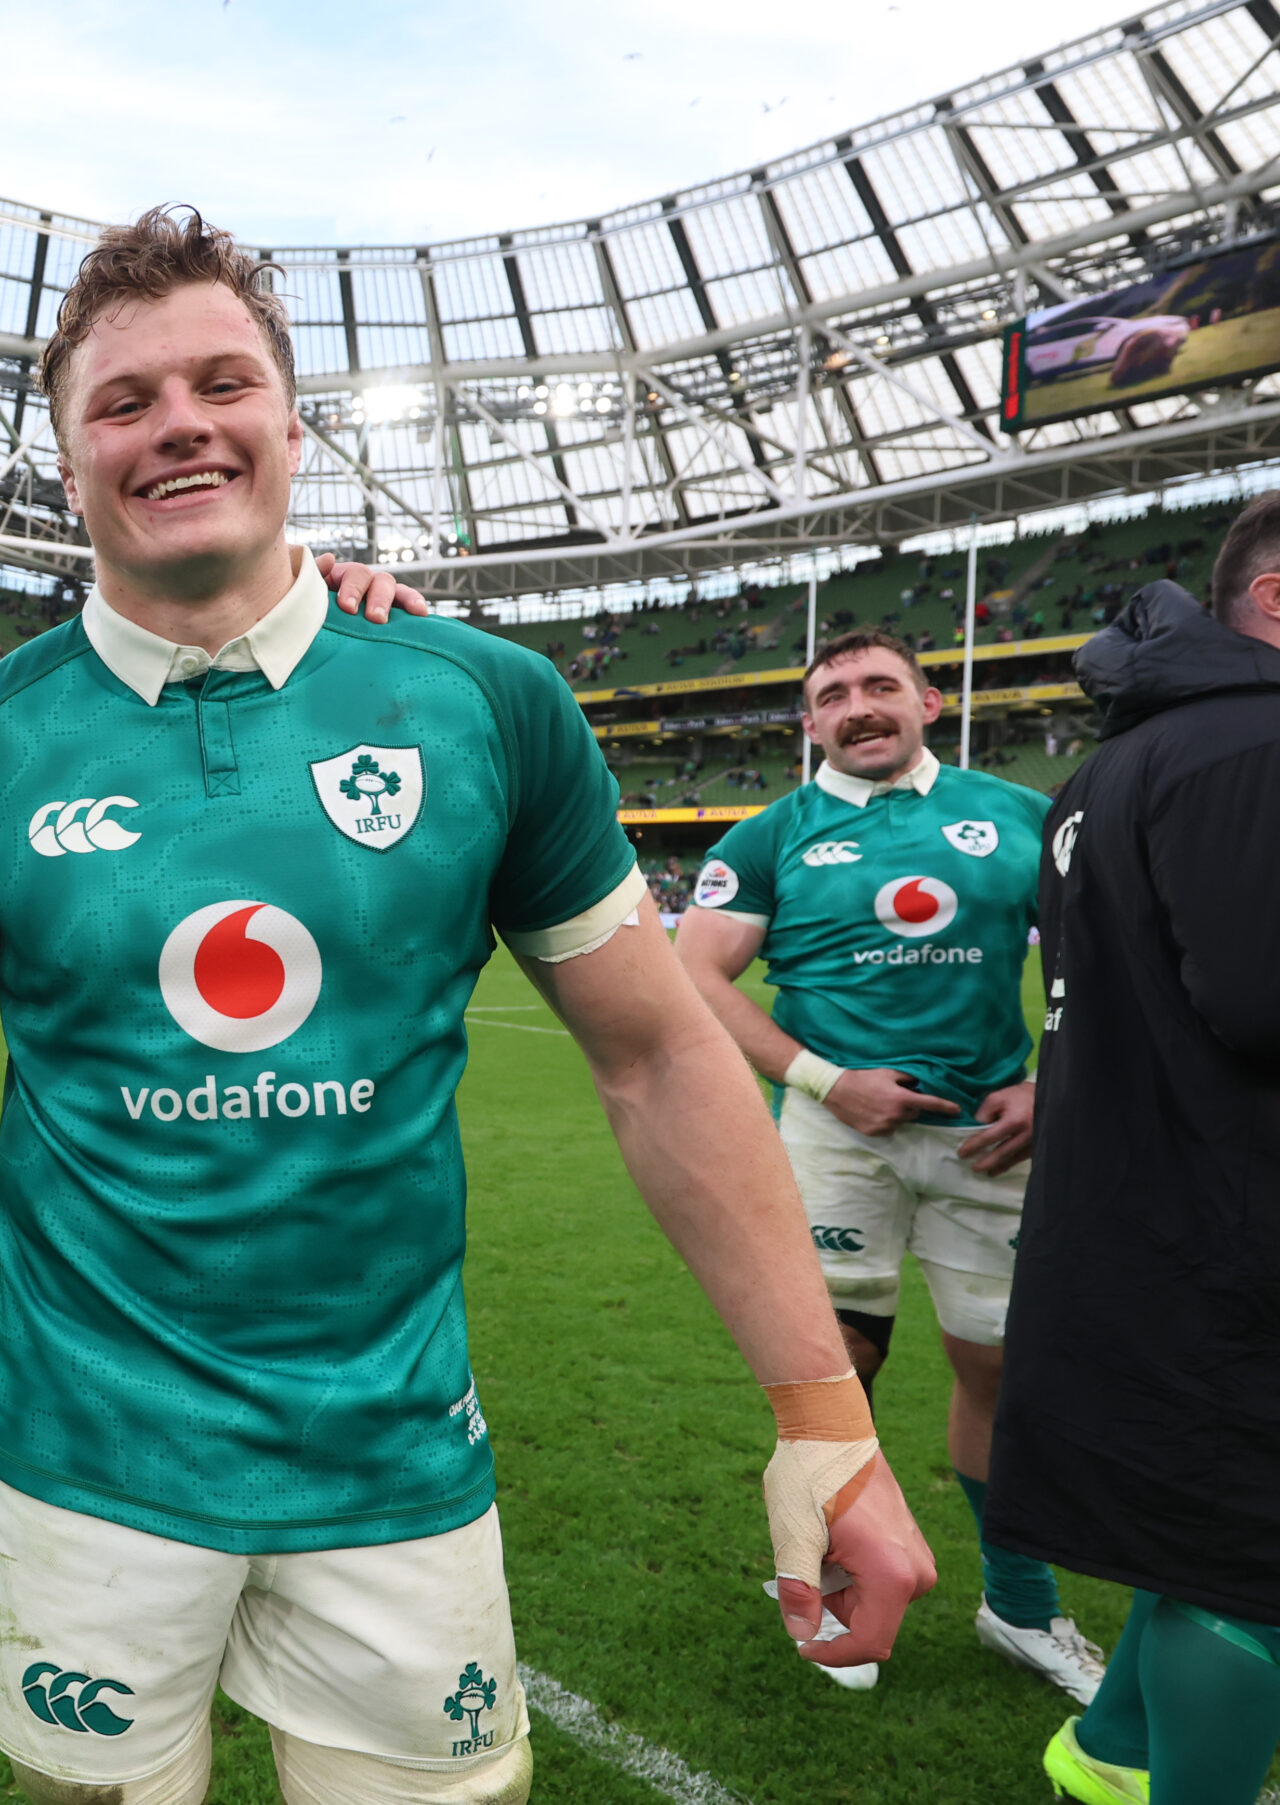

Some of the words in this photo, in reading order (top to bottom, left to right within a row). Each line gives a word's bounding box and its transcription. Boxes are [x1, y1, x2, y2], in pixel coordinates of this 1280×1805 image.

[355, 814, 402, 834] IRFU
[853, 944, 983, 965] vodafone
[121, 1071, 375, 1122] vodafone
[451, 1729, 495, 1757] IRFU
